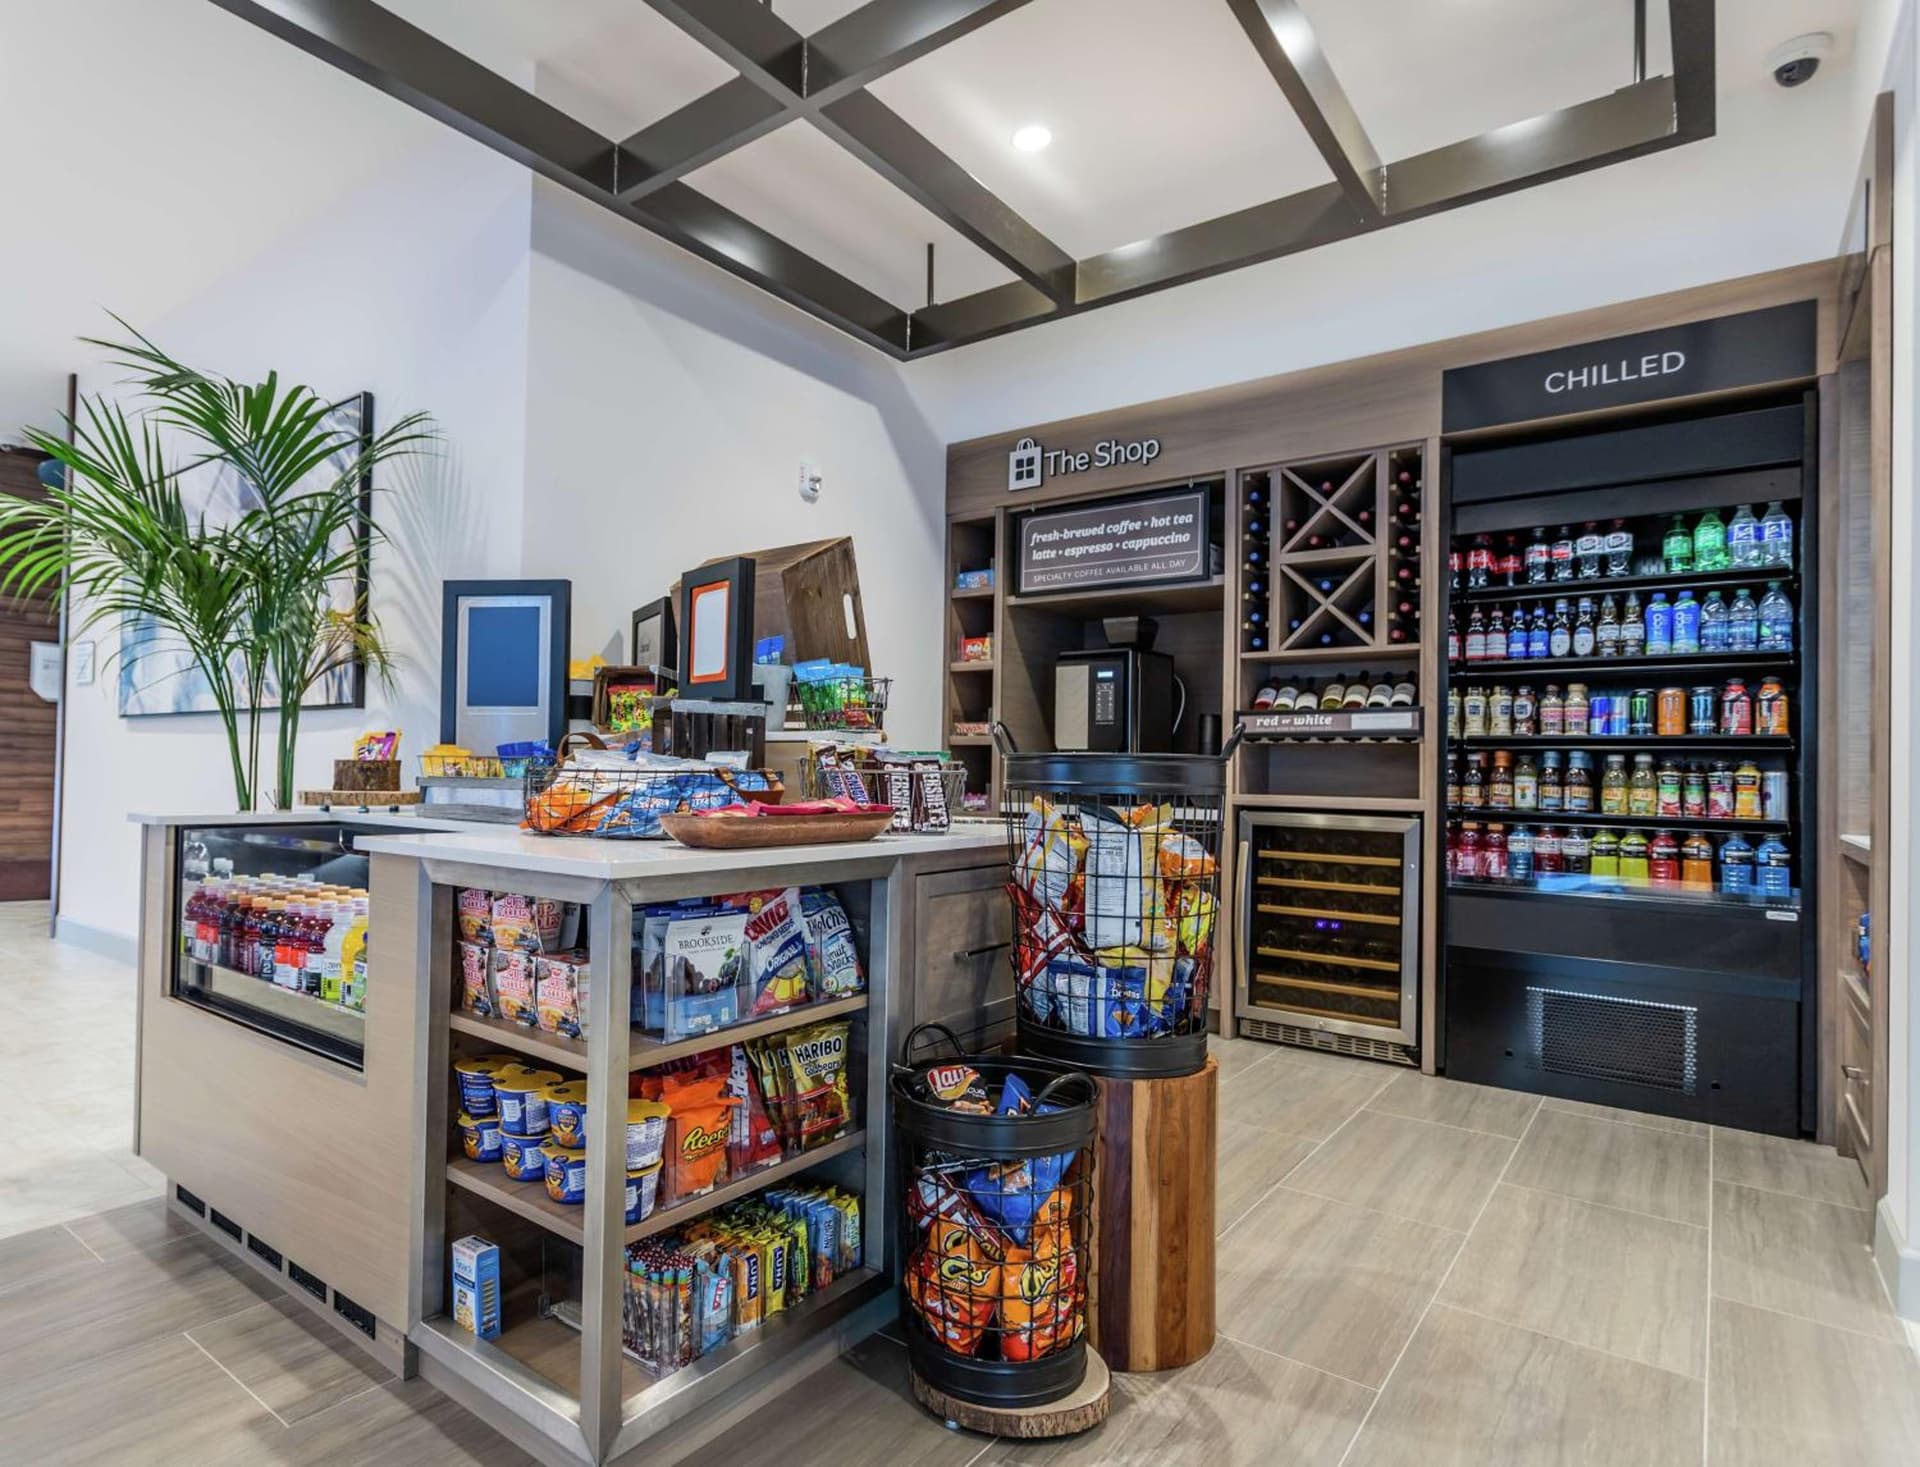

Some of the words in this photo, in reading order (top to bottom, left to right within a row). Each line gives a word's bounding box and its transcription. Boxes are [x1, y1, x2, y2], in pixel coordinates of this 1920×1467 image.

[1544, 351, 1686, 393] CHILLED
[1044, 449, 1090, 476] The
[1094, 439, 1160, 467] Shop
[1030, 523, 1105, 546] fresh-brewed
[1106, 520, 1142, 535] coffee
[1150, 516, 1171, 528] hot
[1173, 514, 1193, 525] tea
[1032, 549, 1057, 560] latte
[1064, 542, 1114, 558] espresso
[1122, 531, 1191, 551] cappuccino
[1034, 572, 1072, 583] SPECIALTY
[1074, 568, 1103, 577] COFFEE
[1105, 563, 1149, 574] AVAILABLE
[1169, 559, 1186, 568] DAY
[1256, 715, 1279, 726] red
[1294, 714, 1333, 726] white
[922, 763, 949, 829] HERSHEY'S
[745, 900, 789, 942] DAVID
[807, 909, 848, 937] Welch's
[678, 934, 736, 950] BROOKSIDE
[767, 940, 802, 972] ORIGINAL
[795, 1037, 842, 1063] HARIBO
[804, 1060, 842, 1078] Goldbears
[748, 1255, 758, 1297] LUNA
[775, 1249, 784, 1289] LUNA
